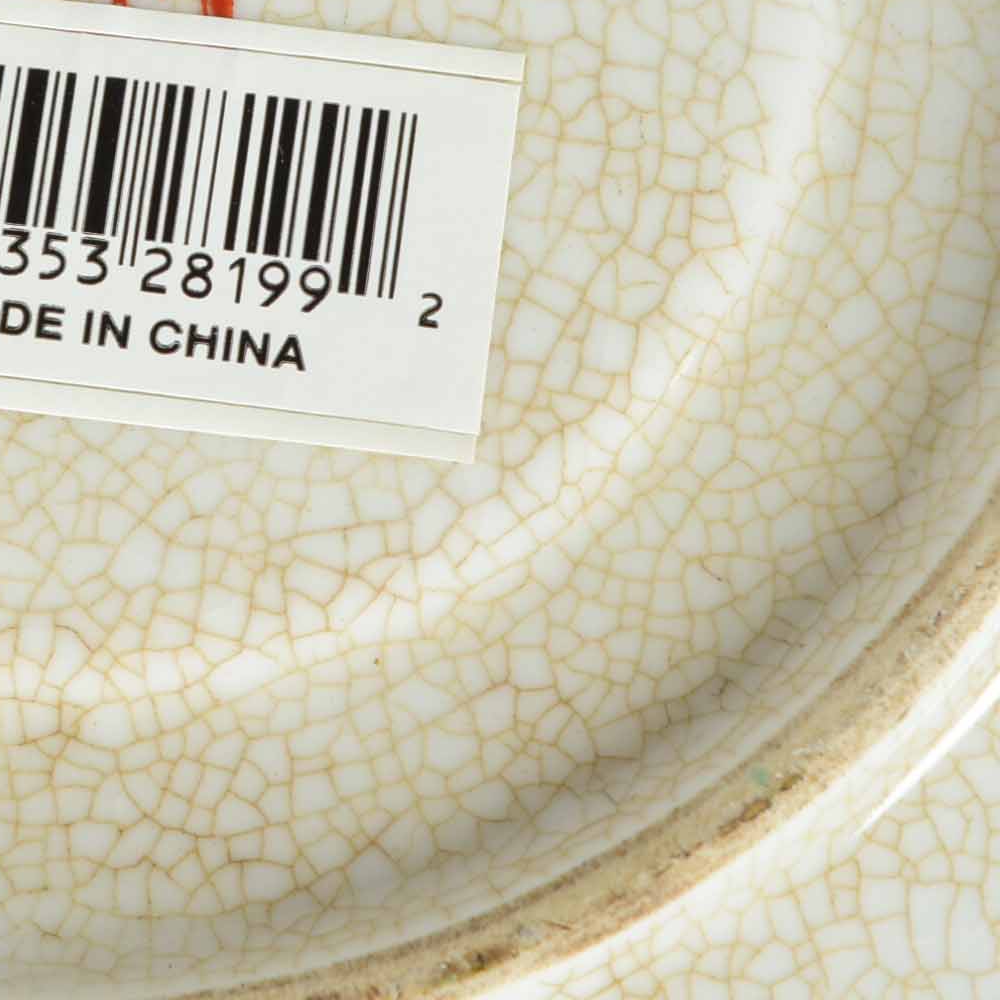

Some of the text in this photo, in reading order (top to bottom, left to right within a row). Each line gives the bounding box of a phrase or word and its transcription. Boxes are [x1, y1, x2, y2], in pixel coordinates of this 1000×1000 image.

[140, 247, 332, 314] 28199
[418, 292, 443, 329] 2
[82, 310, 132, 349] IN
[149, 319, 305, 371] CHINA
